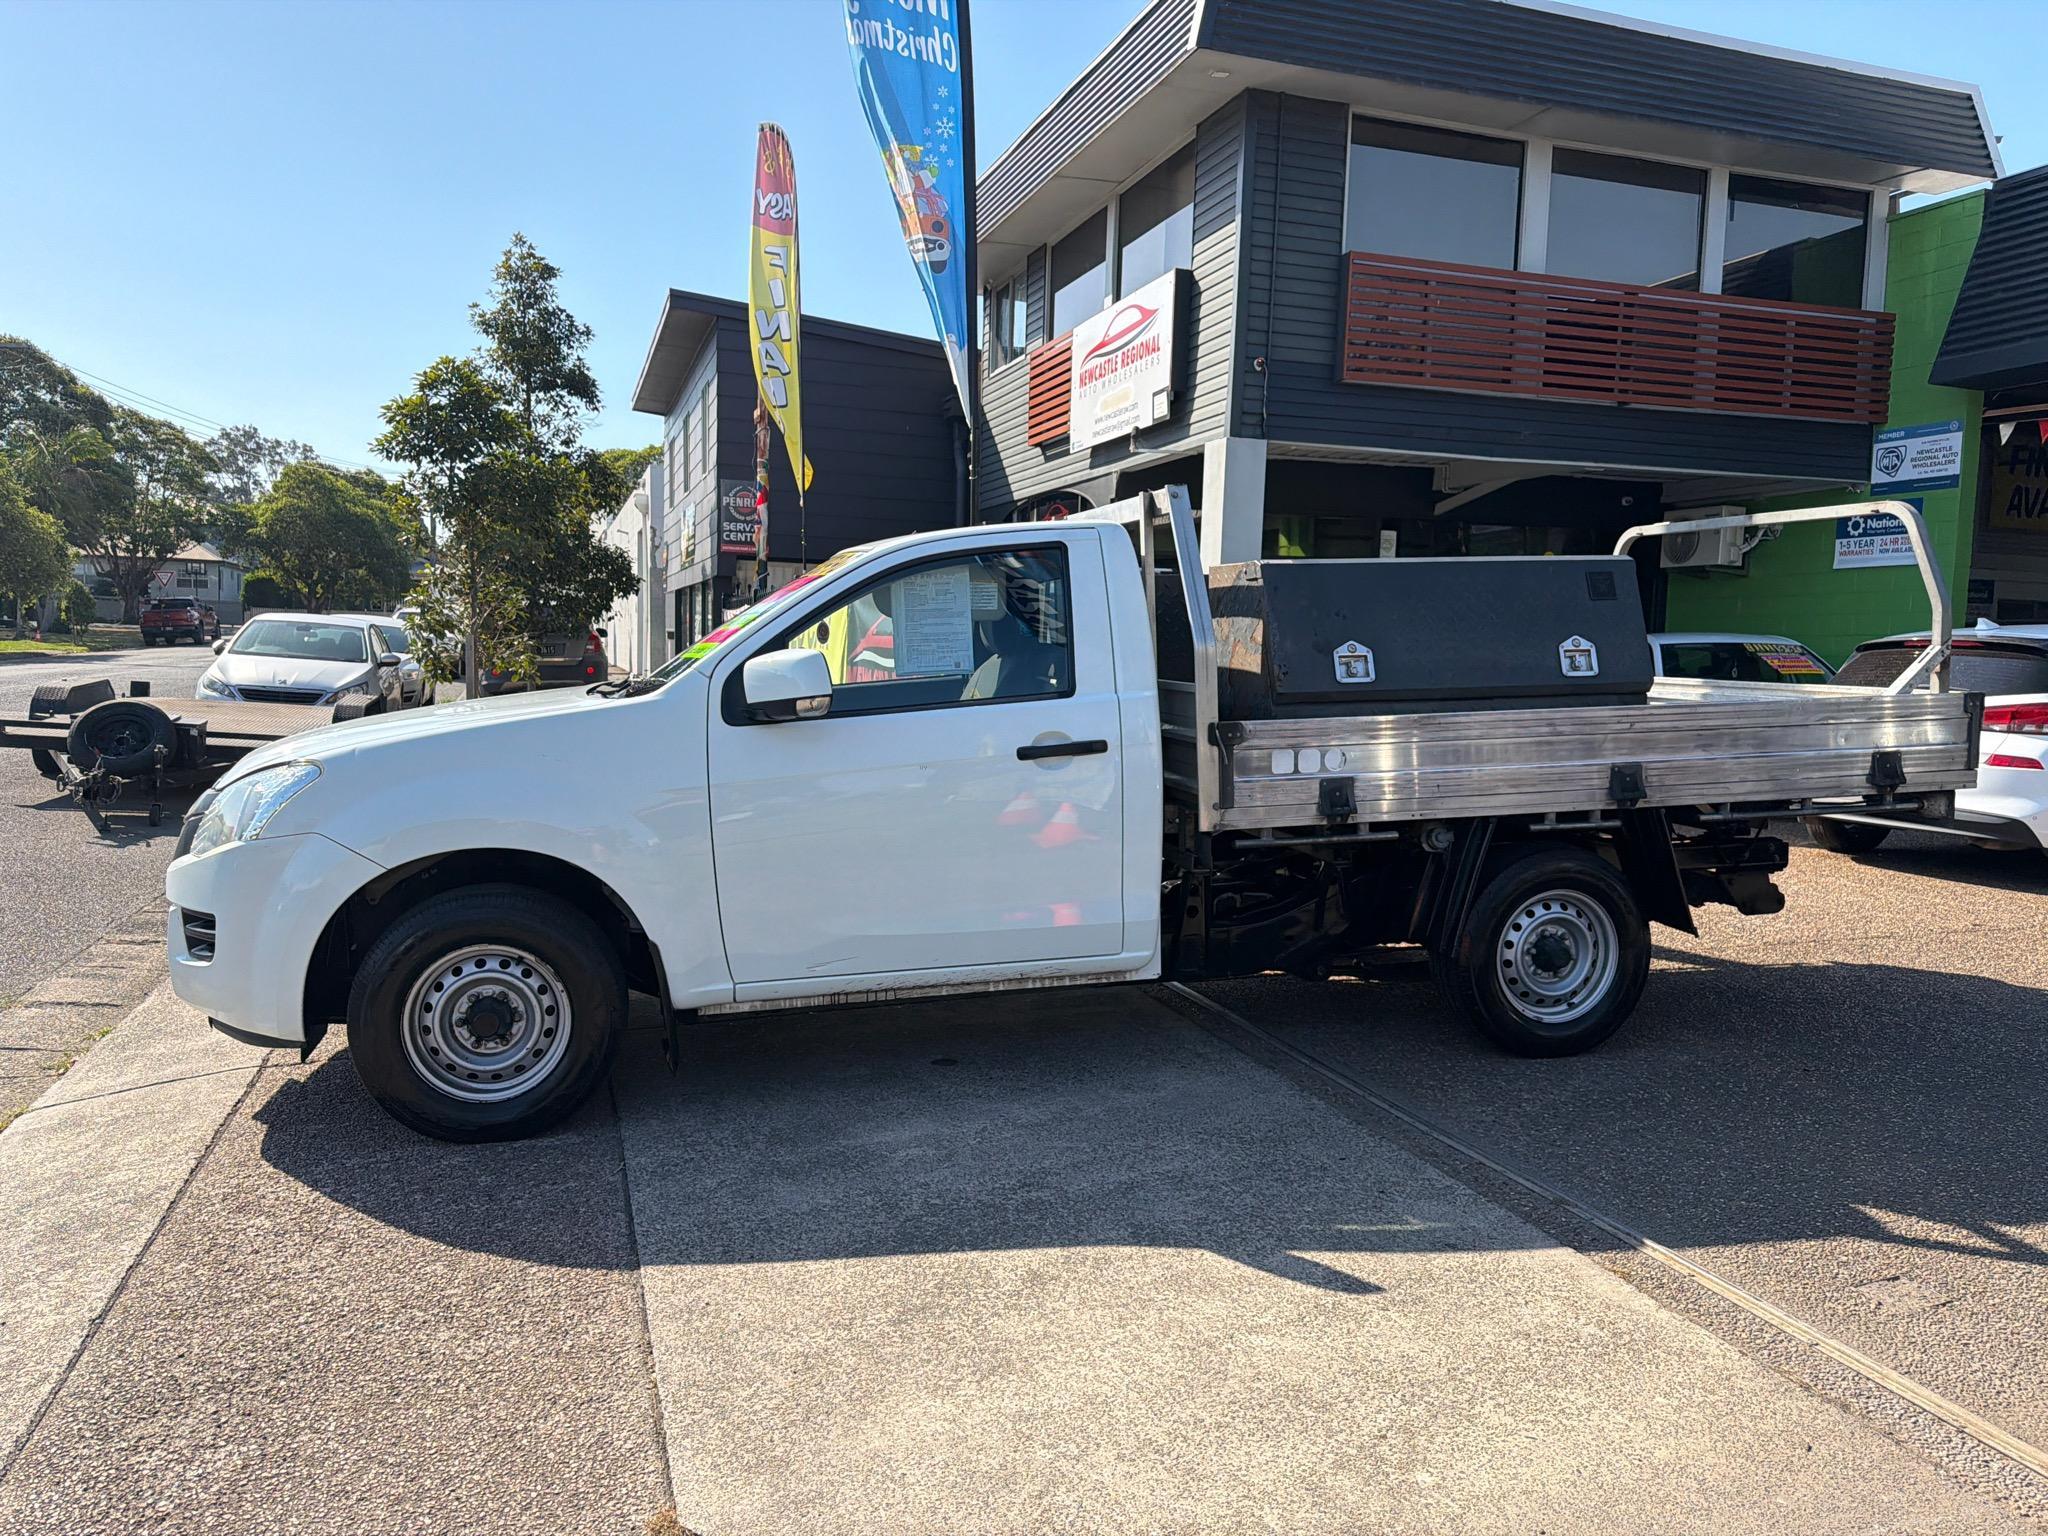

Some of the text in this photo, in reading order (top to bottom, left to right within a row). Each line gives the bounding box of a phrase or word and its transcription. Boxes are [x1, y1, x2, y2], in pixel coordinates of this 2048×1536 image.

[1079, 333, 1161, 389] NEWCASTLE REGIONAL
[1079, 354, 1161, 399] AUTO WHOLESALERS
[1878, 430, 1906, 441] MEMBER
[1916, 445, 1953, 456] NEWCASTLE
[1910, 451, 1959, 463] REGIONAL AUTO
[1912, 459, 1956, 470] WHOLESALERS
[722, 496, 755, 507] PENRI
[723, 521, 755, 532] SERV
[1867, 516, 1905, 529] Nation
[723, 532, 752, 542] CENT
[1880, 539, 1888, 547] 24
[1890, 537, 1900, 546] HR
[1840, 539, 1875, 550] 1-5 YEAR
[1839, 549, 1873, 557] WARRANTIES
